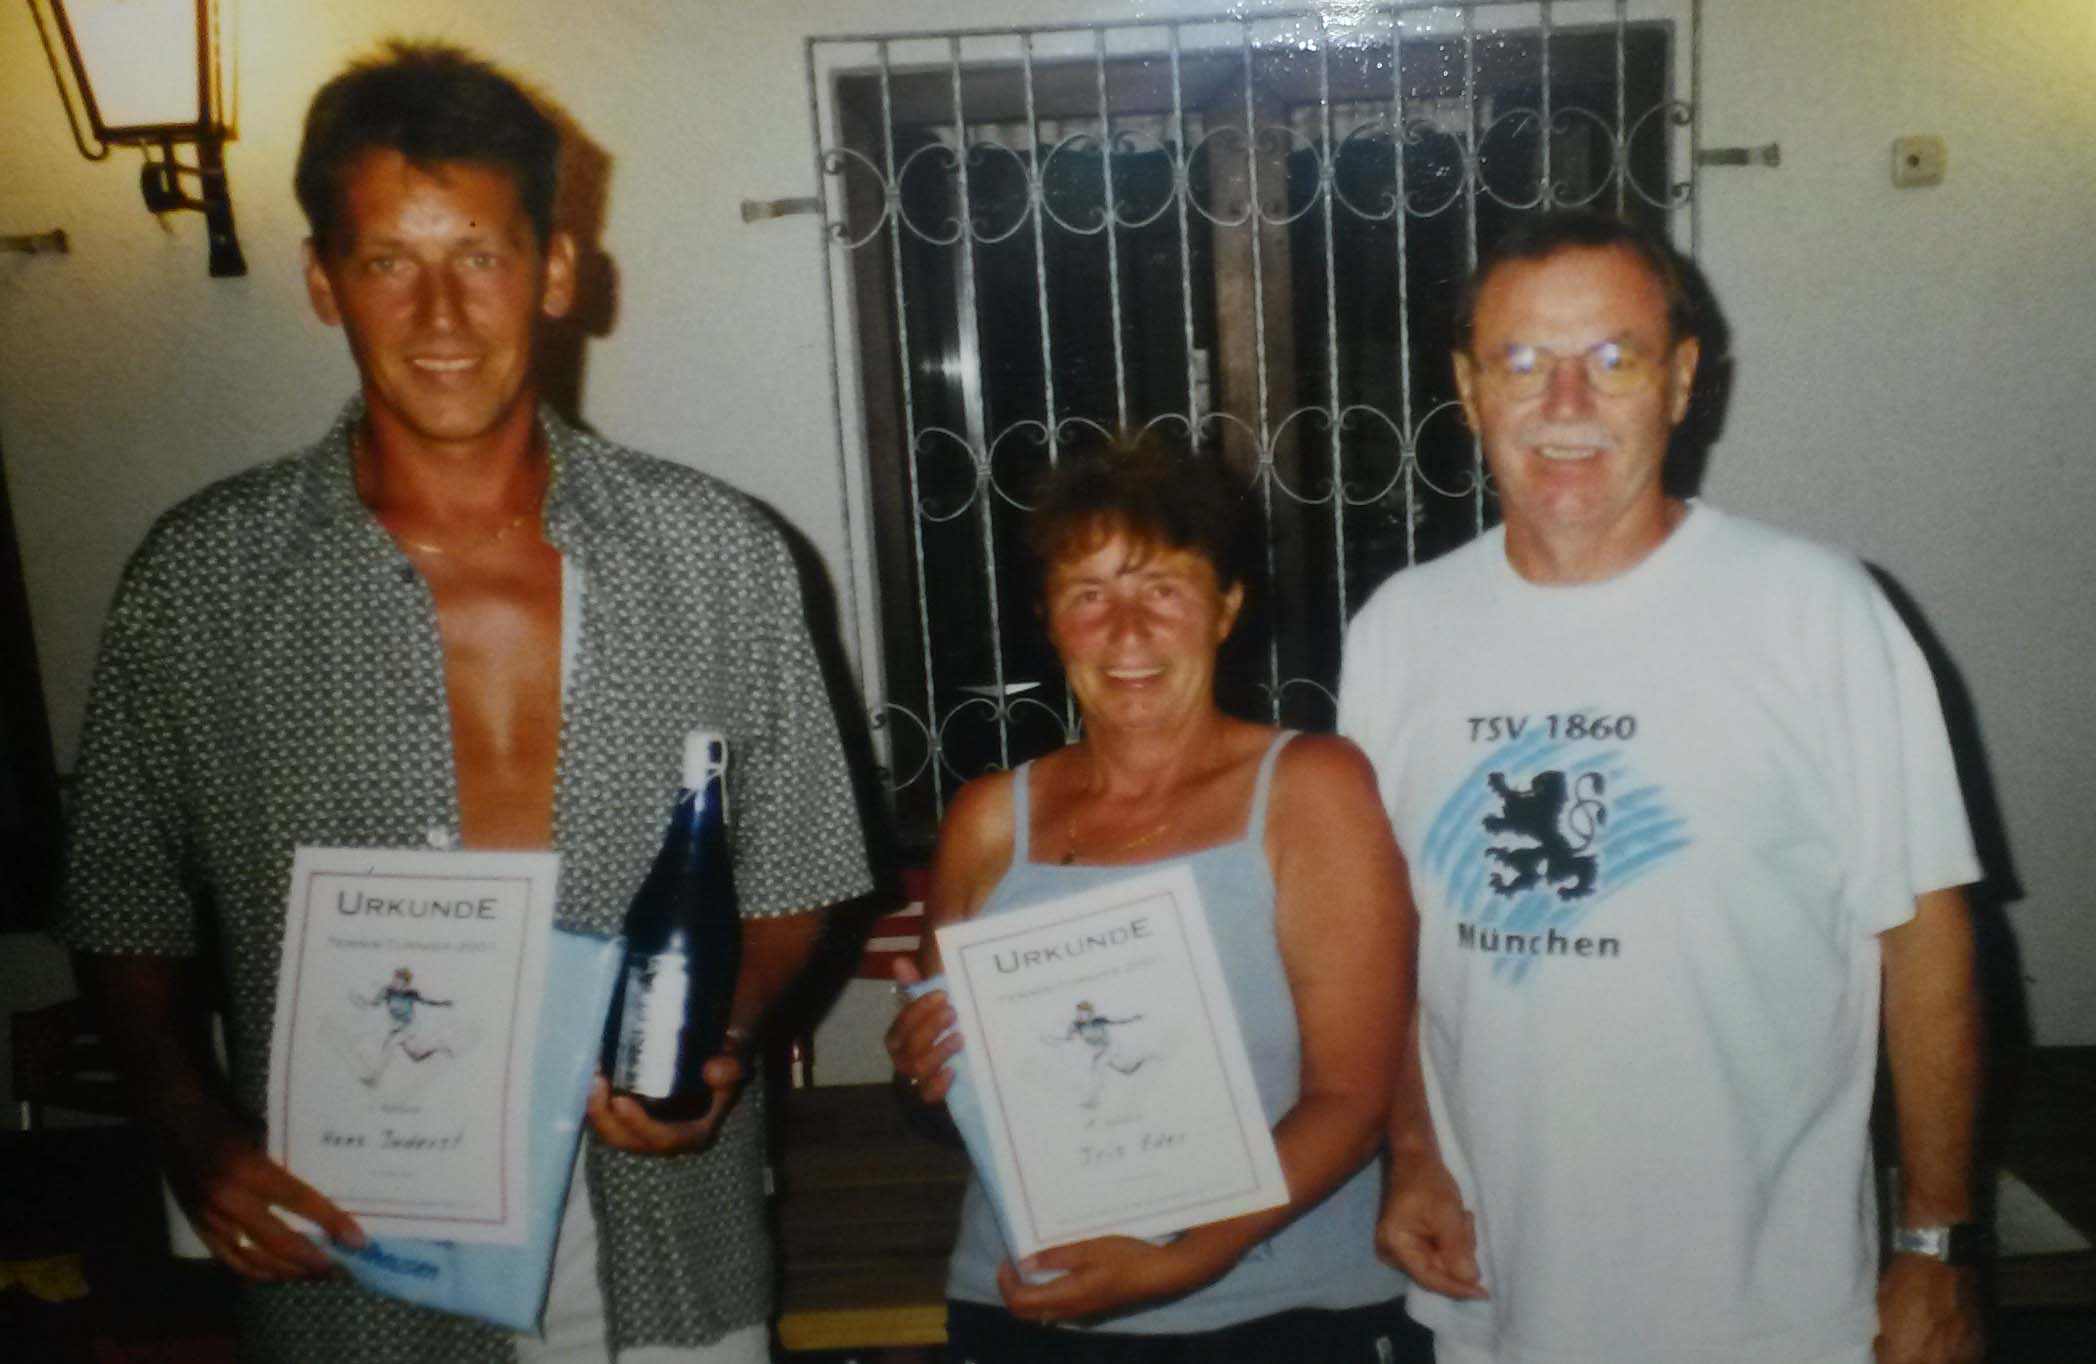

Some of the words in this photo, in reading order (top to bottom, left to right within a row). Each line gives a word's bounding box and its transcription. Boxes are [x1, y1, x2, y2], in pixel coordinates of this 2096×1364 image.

[1467, 715, 1528, 742] TSV
[1546, 713, 1637, 741] 1860
[337, 890, 498, 921] URKUNDE
[993, 917, 1154, 974] URKUNDE
[1457, 921, 1621, 957] München
